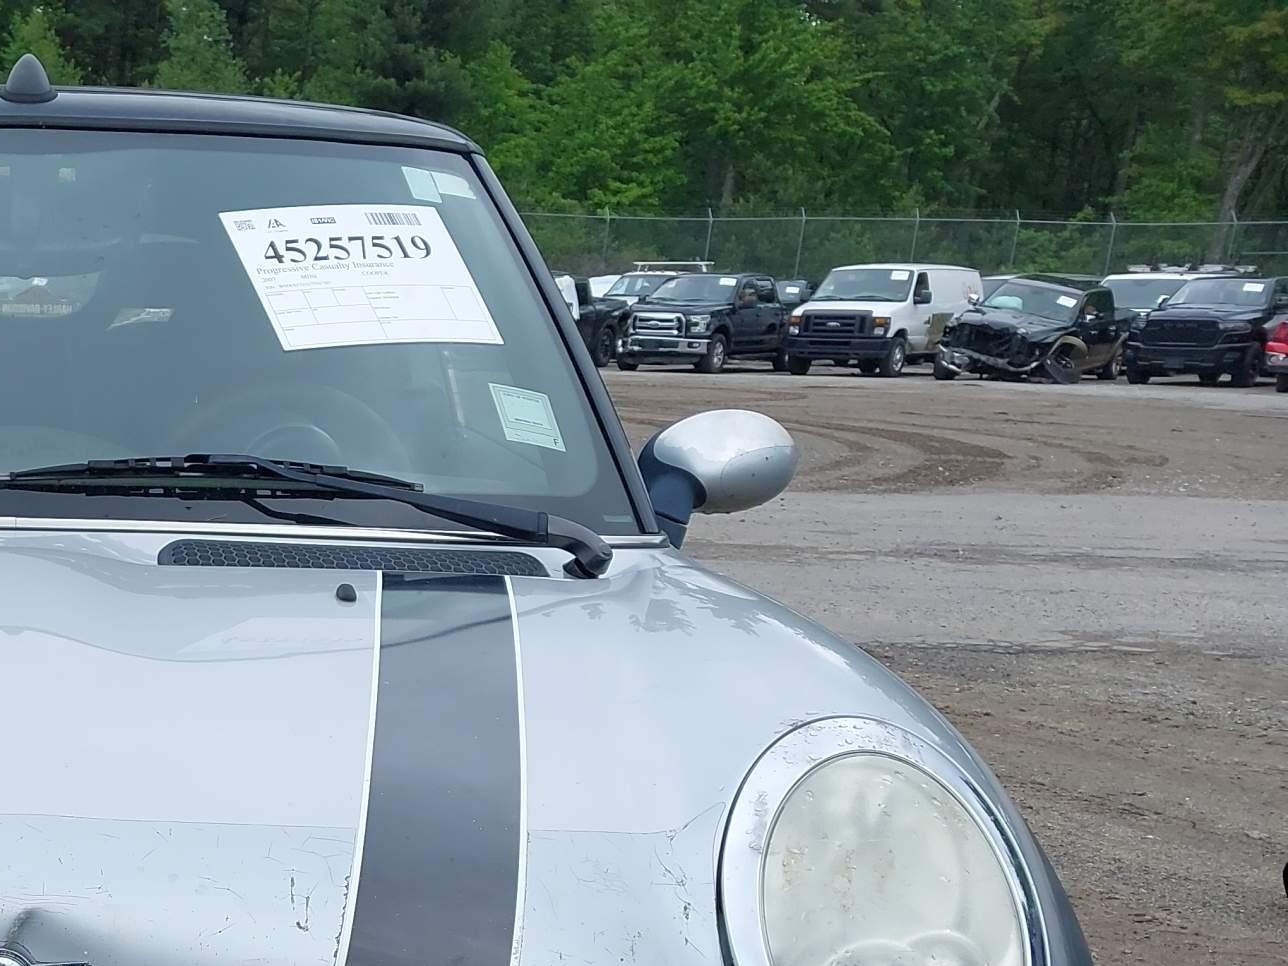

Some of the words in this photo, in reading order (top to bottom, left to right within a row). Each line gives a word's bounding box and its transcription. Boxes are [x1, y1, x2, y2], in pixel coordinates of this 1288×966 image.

[264, 234, 432, 264] 45257519
[257, 263, 310, 276] Progressive
[311, 261, 350, 271] Casualty
[353, 260, 395, 269] Insurance
